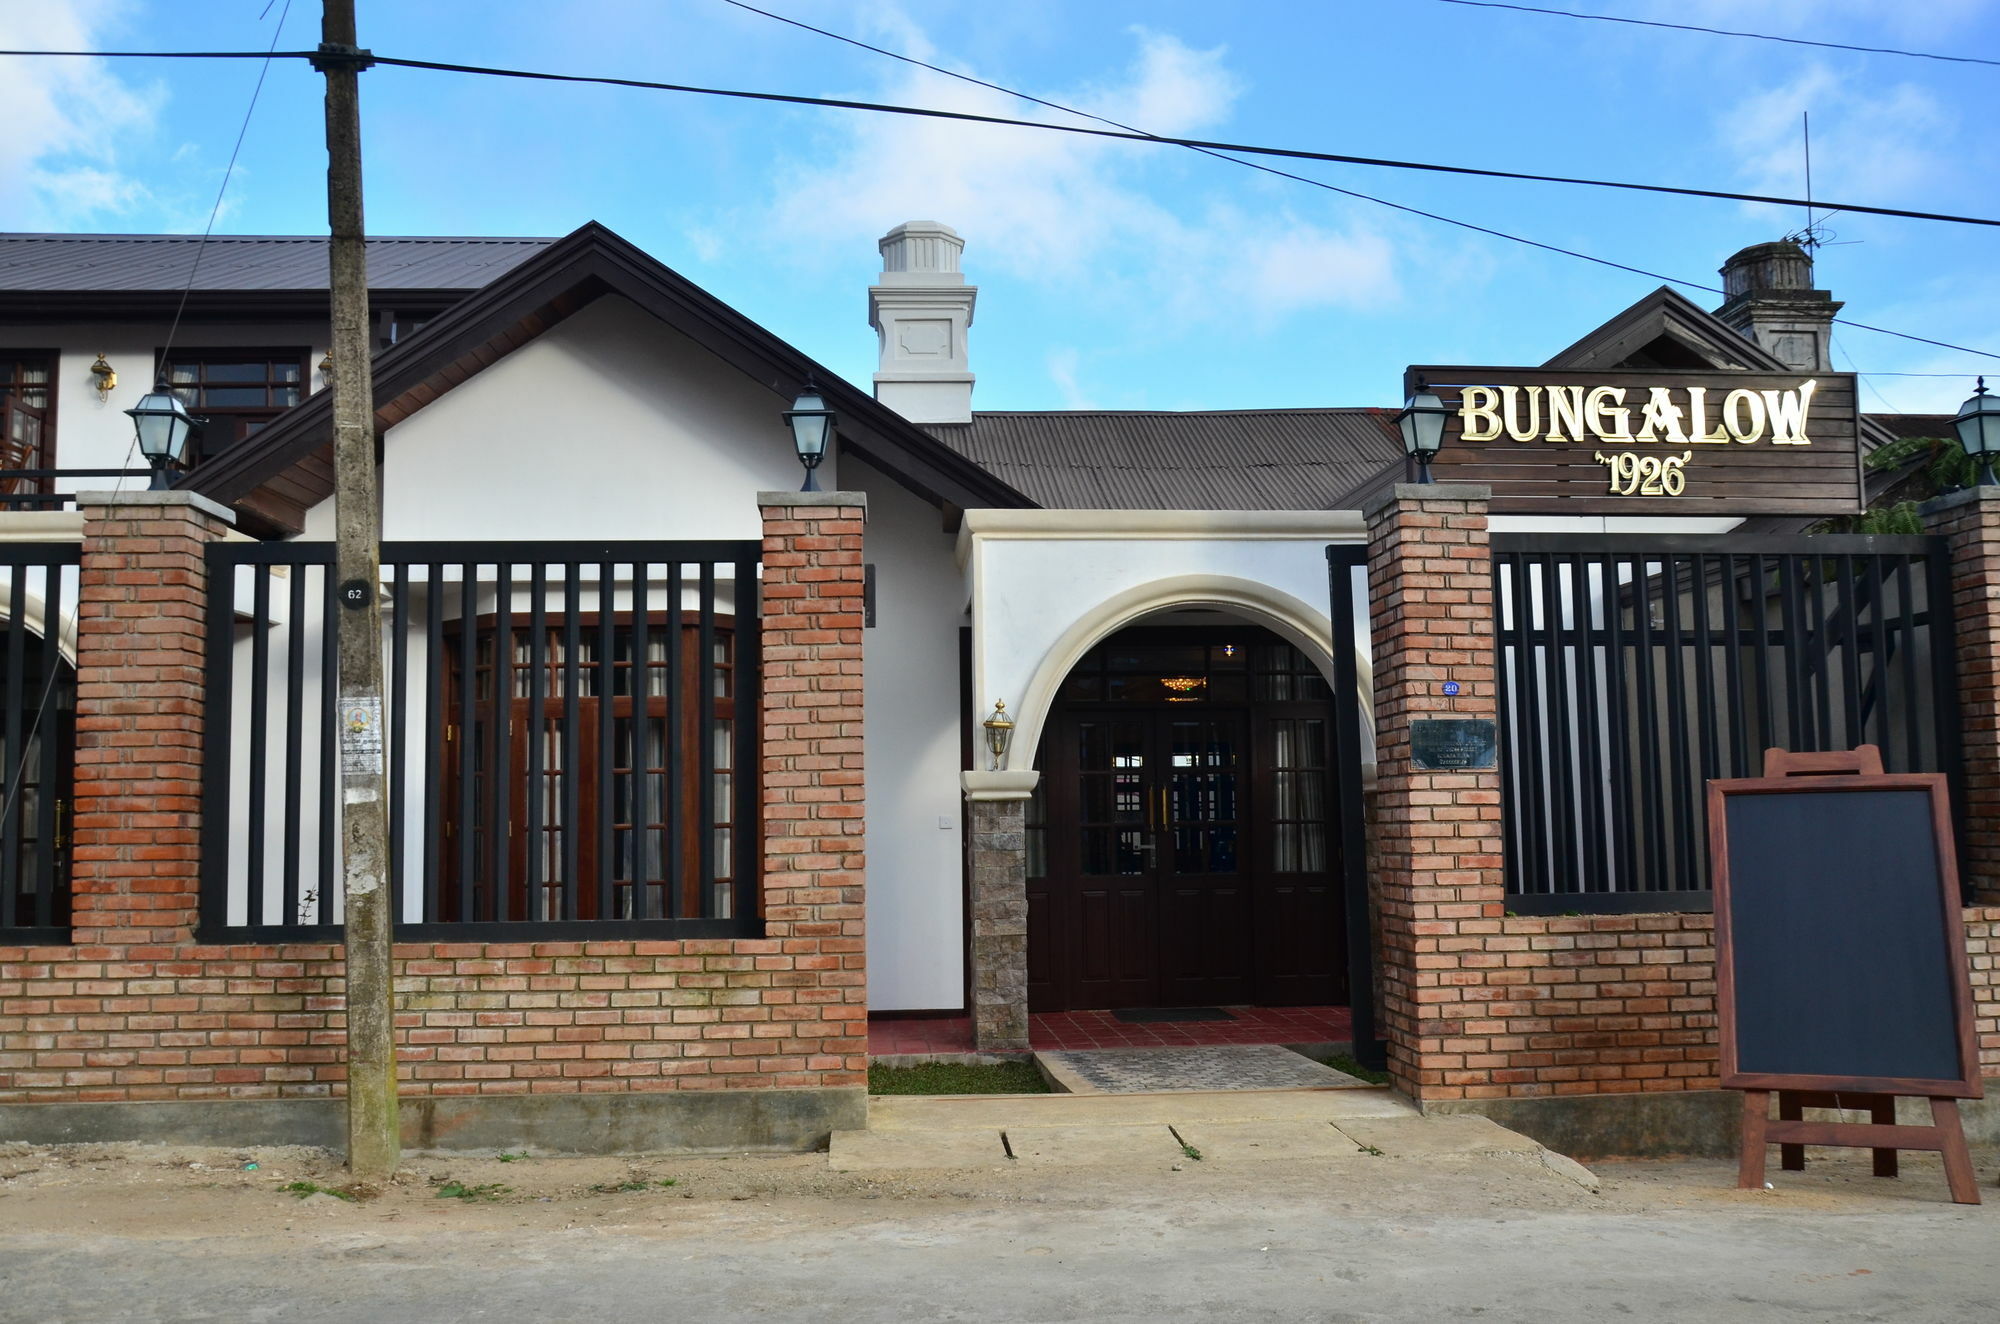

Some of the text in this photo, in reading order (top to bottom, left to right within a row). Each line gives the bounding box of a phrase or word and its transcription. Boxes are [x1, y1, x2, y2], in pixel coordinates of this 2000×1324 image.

[1458, 379, 1817, 446] BUNGALOW
[1595, 450, 1692, 496] 1926
[347, 589, 362, 599] 62
[1445, 684, 1458, 692] 20
